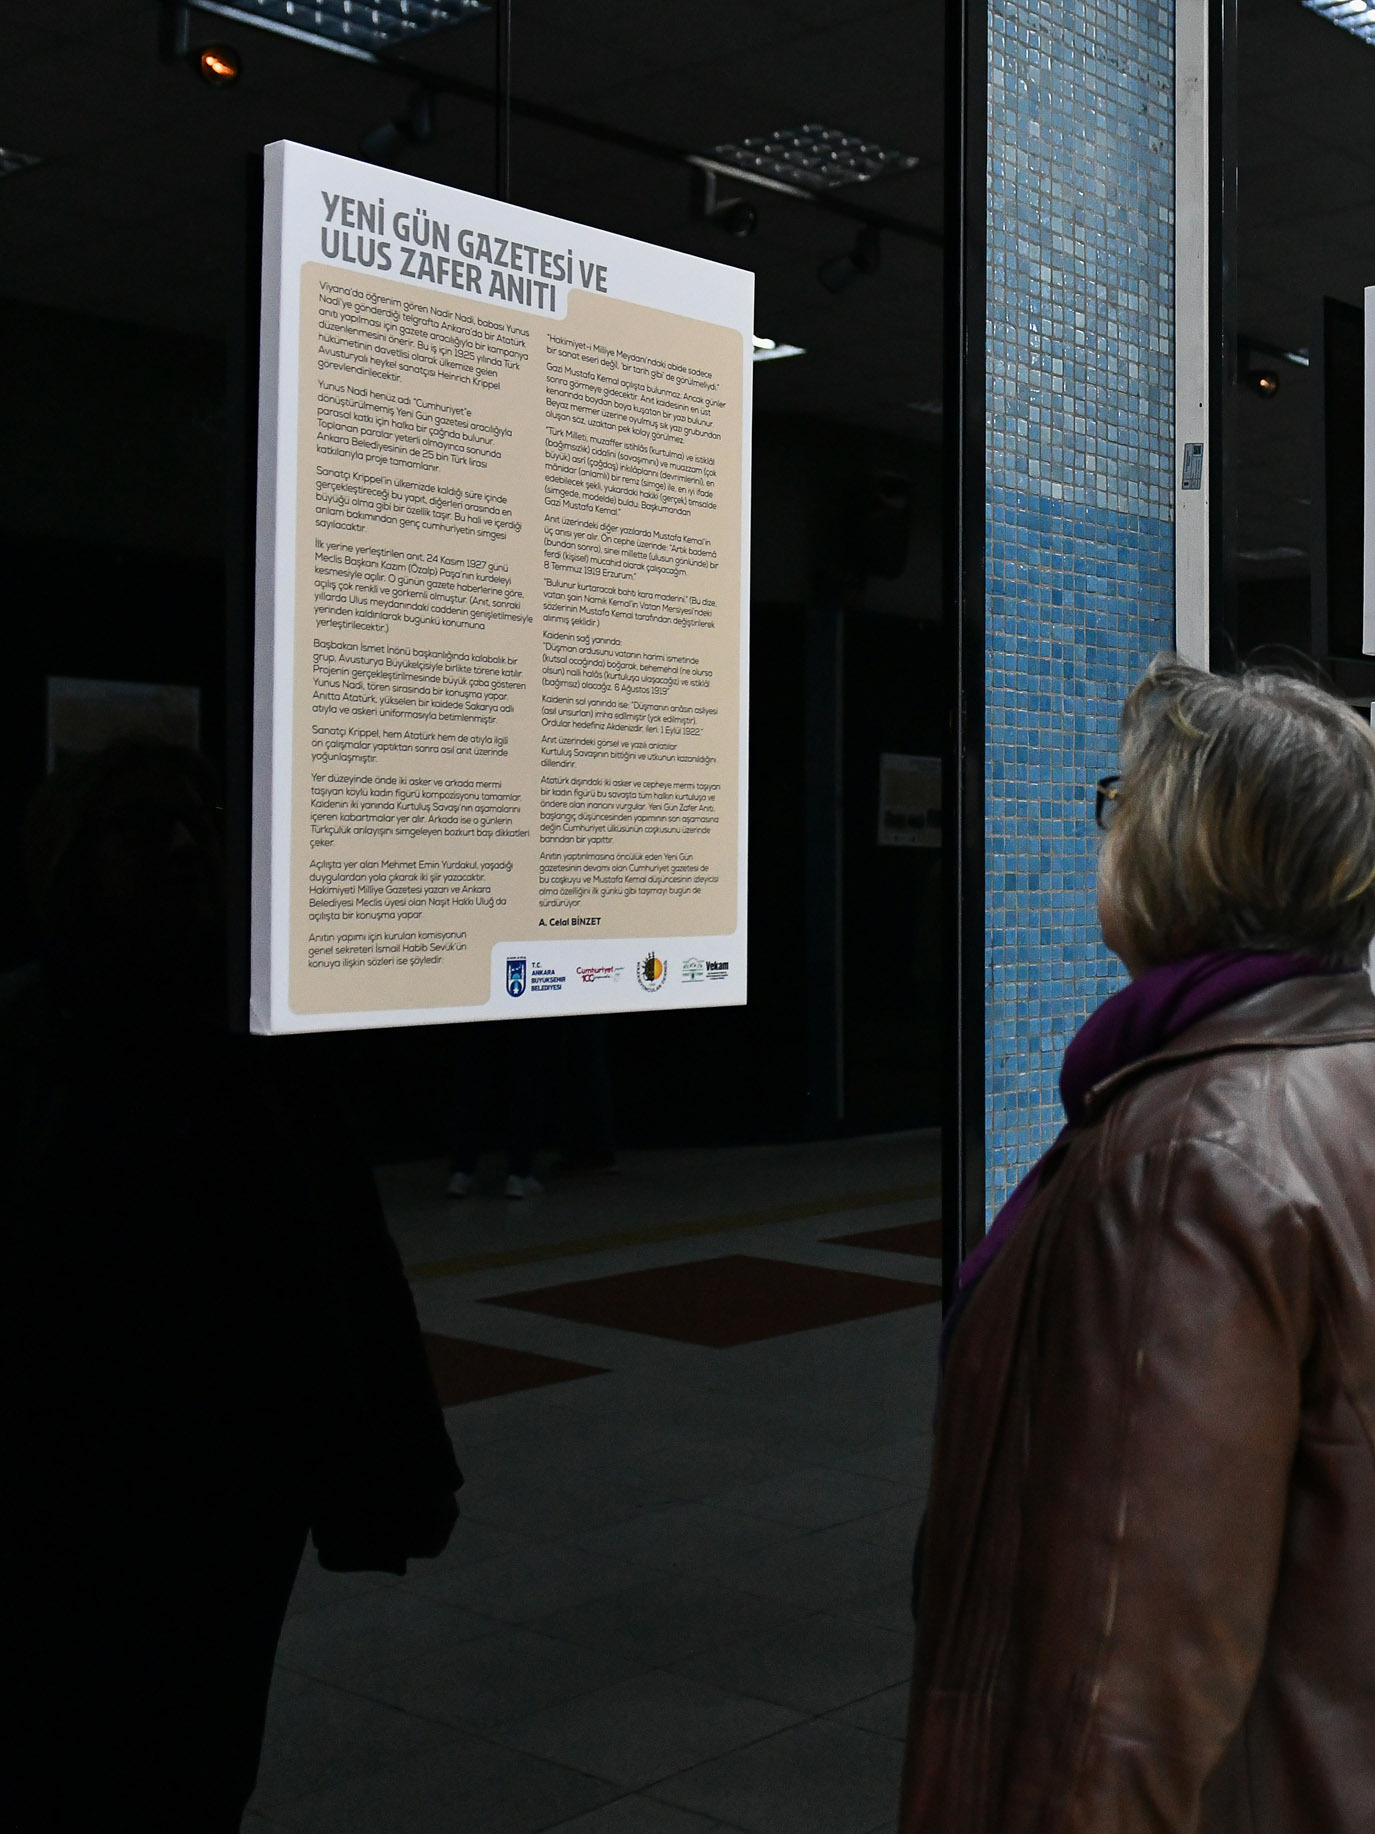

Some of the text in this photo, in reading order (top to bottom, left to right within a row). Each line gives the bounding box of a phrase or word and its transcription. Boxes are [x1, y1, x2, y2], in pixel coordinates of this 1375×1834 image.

[321, 190, 608, 293] YENİ GÜN GAZETESİ VE
[321, 226, 556, 312] ULUS ZAFER ANITI
[319, 280, 364, 298] Viyana'da
[365, 292, 401, 307] öğrenim
[403, 301, 428, 313] gören
[430, 306, 453, 318] Nadir
[477, 317, 504, 330] babası
[506, 324, 529, 336] Yunus
[319, 293, 525, 347] Nadi'ye gönderdiği telgrafta Ankara'da bir Atatürk
[316, 417, 501, 458] Toplanan paralar yeterli olmayınca sonunda
[315, 538, 324, 548] İlk
[325, 542, 353, 552] yerine
[426, 553, 438, 562] 24
[440, 555, 464, 566] Kasım
[466, 558, 486, 569] 1927
[487, 563, 508, 573] günü
[312, 677, 340, 688] Yunus
[366, 681, 390, 691] tören
[392, 685, 430, 694] sırasında
[432, 686, 443, 695] bir
[445, 687, 482, 699] konuşma
[309, 859, 341, 870] Açılışta
[343, 861, 358, 870] yer
[359, 860, 379, 868] alan
[380, 859, 416, 868] Mehmet
[418, 859, 439, 868] Emin
[479, 860, 513, 871] yaşadığı
[549, 917, 569, 926] Celal
[571, 916, 601, 925] BİNZET
[706, 960, 729, 971] Vekam
